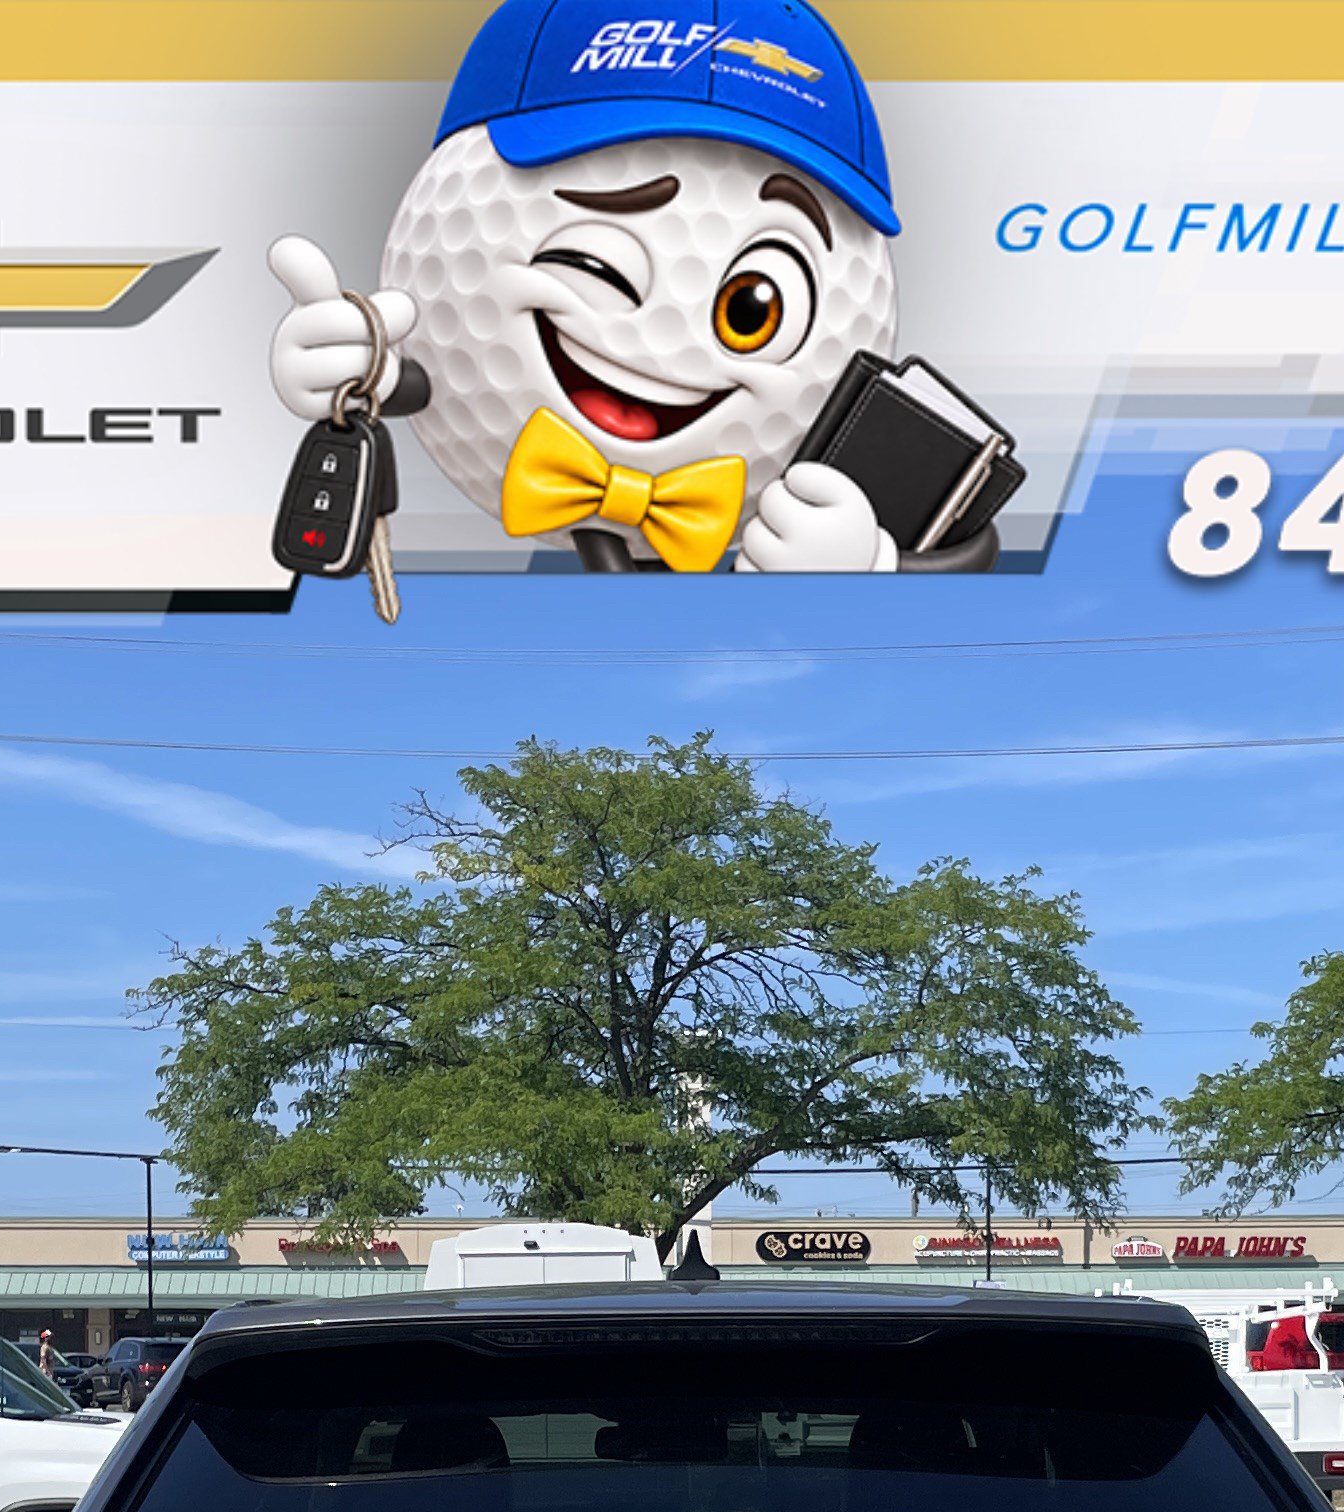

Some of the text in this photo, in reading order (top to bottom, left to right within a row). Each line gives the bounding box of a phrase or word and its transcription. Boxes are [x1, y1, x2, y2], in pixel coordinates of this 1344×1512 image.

[788, 1232, 863, 1250] crave
[1114, 1243, 1134, 1256] PAPA
[1173, 1236, 1307, 1257] PAPA JOHN'S
